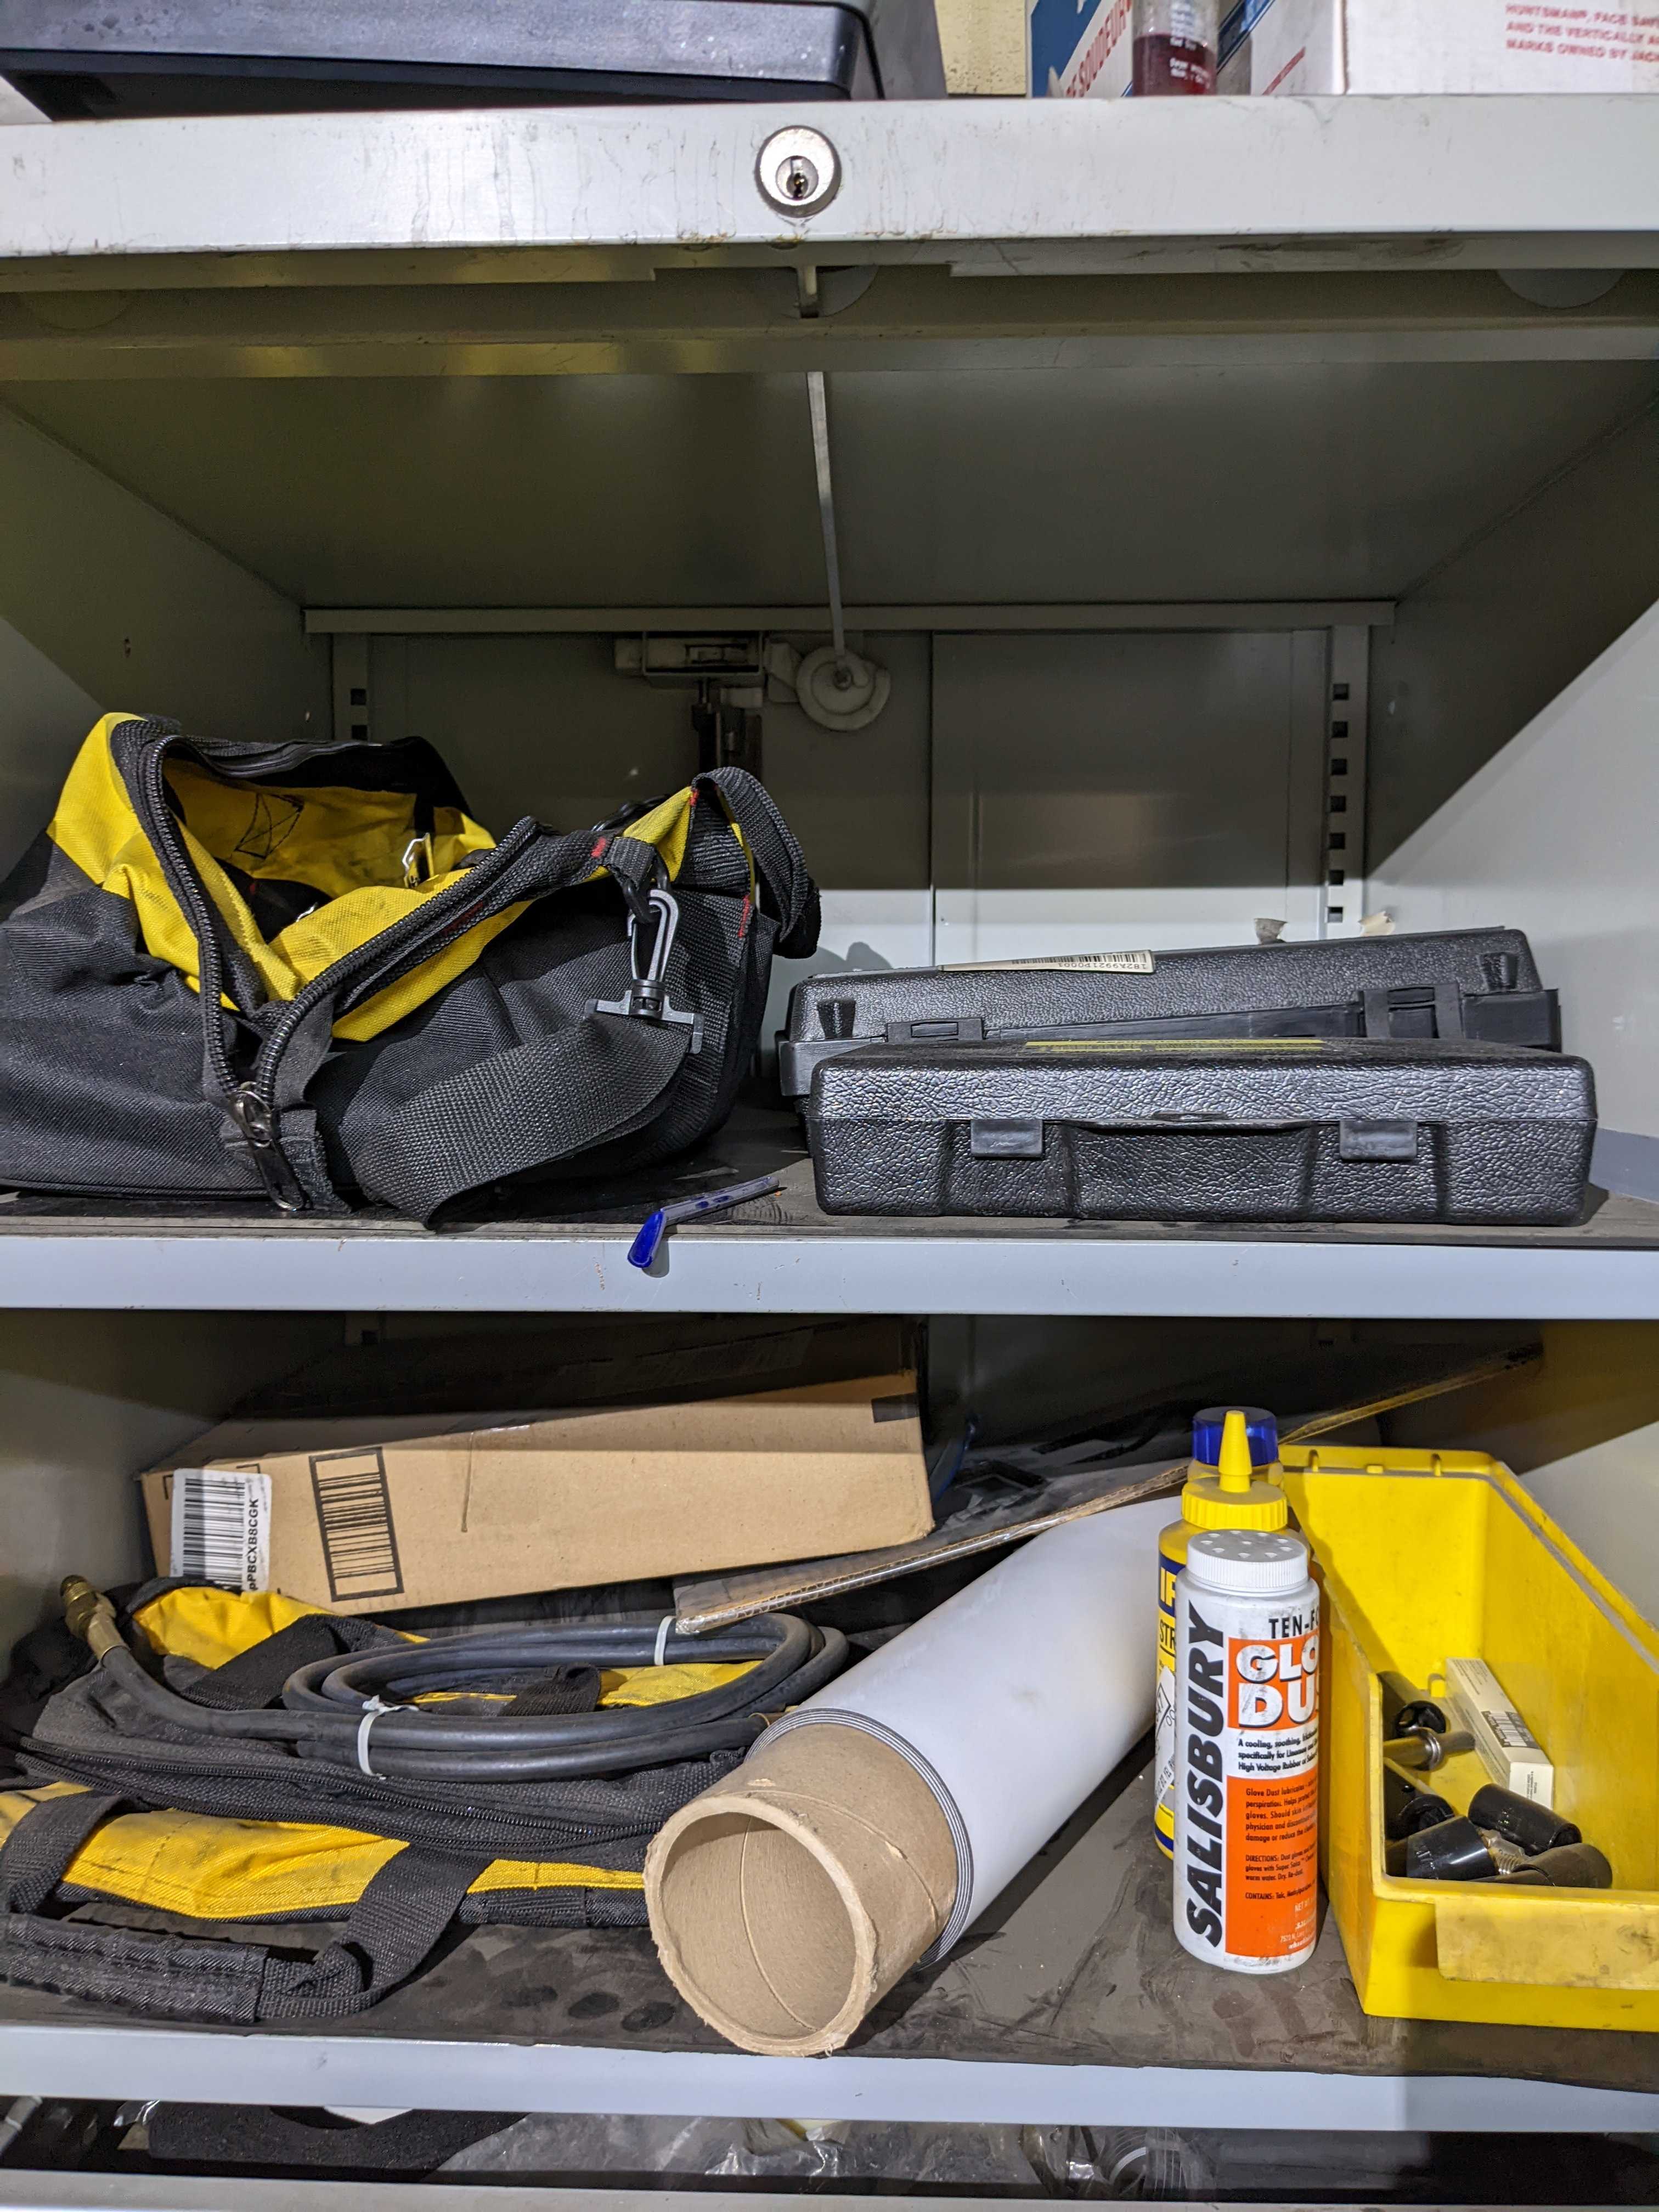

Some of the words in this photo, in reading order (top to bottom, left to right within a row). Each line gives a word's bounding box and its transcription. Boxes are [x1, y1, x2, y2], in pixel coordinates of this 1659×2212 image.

[1506, 22, 1534, 33] AND
[1538, 24, 1561, 36] THE
[1566, 27, 1644, 43] VERTICALLY
[1506, 39, 1553, 53] MARKS
[1557, 43, 1606, 58] OWNED
[1609, 48, 1628, 59] BY
[1268, 1606, 1319, 1639] TEN-F
[1239, 1674, 1319, 1728] DU
[1238, 1739, 1243, 1747] A
[1245, 1740, 1273, 1749] cooling,
[1274, 1737, 1301, 1747] soothing,
[1238, 1751, 1274, 1760] specifically
[1238, 1762, 1254, 1772] High
[1256, 1762, 1281, 1773] Voltage
[1283, 1760, 1301, 1769] Rubber
[1187, 1599, 1224, 1947] SALISBURY
[1246, 1788, 1264, 1796] Glove
[1245, 1800, 1282, 1809] perspiration.
[1245, 1811, 1268, 1820] gloves.
[1271, 1809, 1290, 1819] Should
[1245, 1822, 1273, 1831] physician
[1275, 1821, 1285, 1830] and
[1246, 1833, 1270, 1843] damage
[1279, 1832, 1295, 1840] reduce
